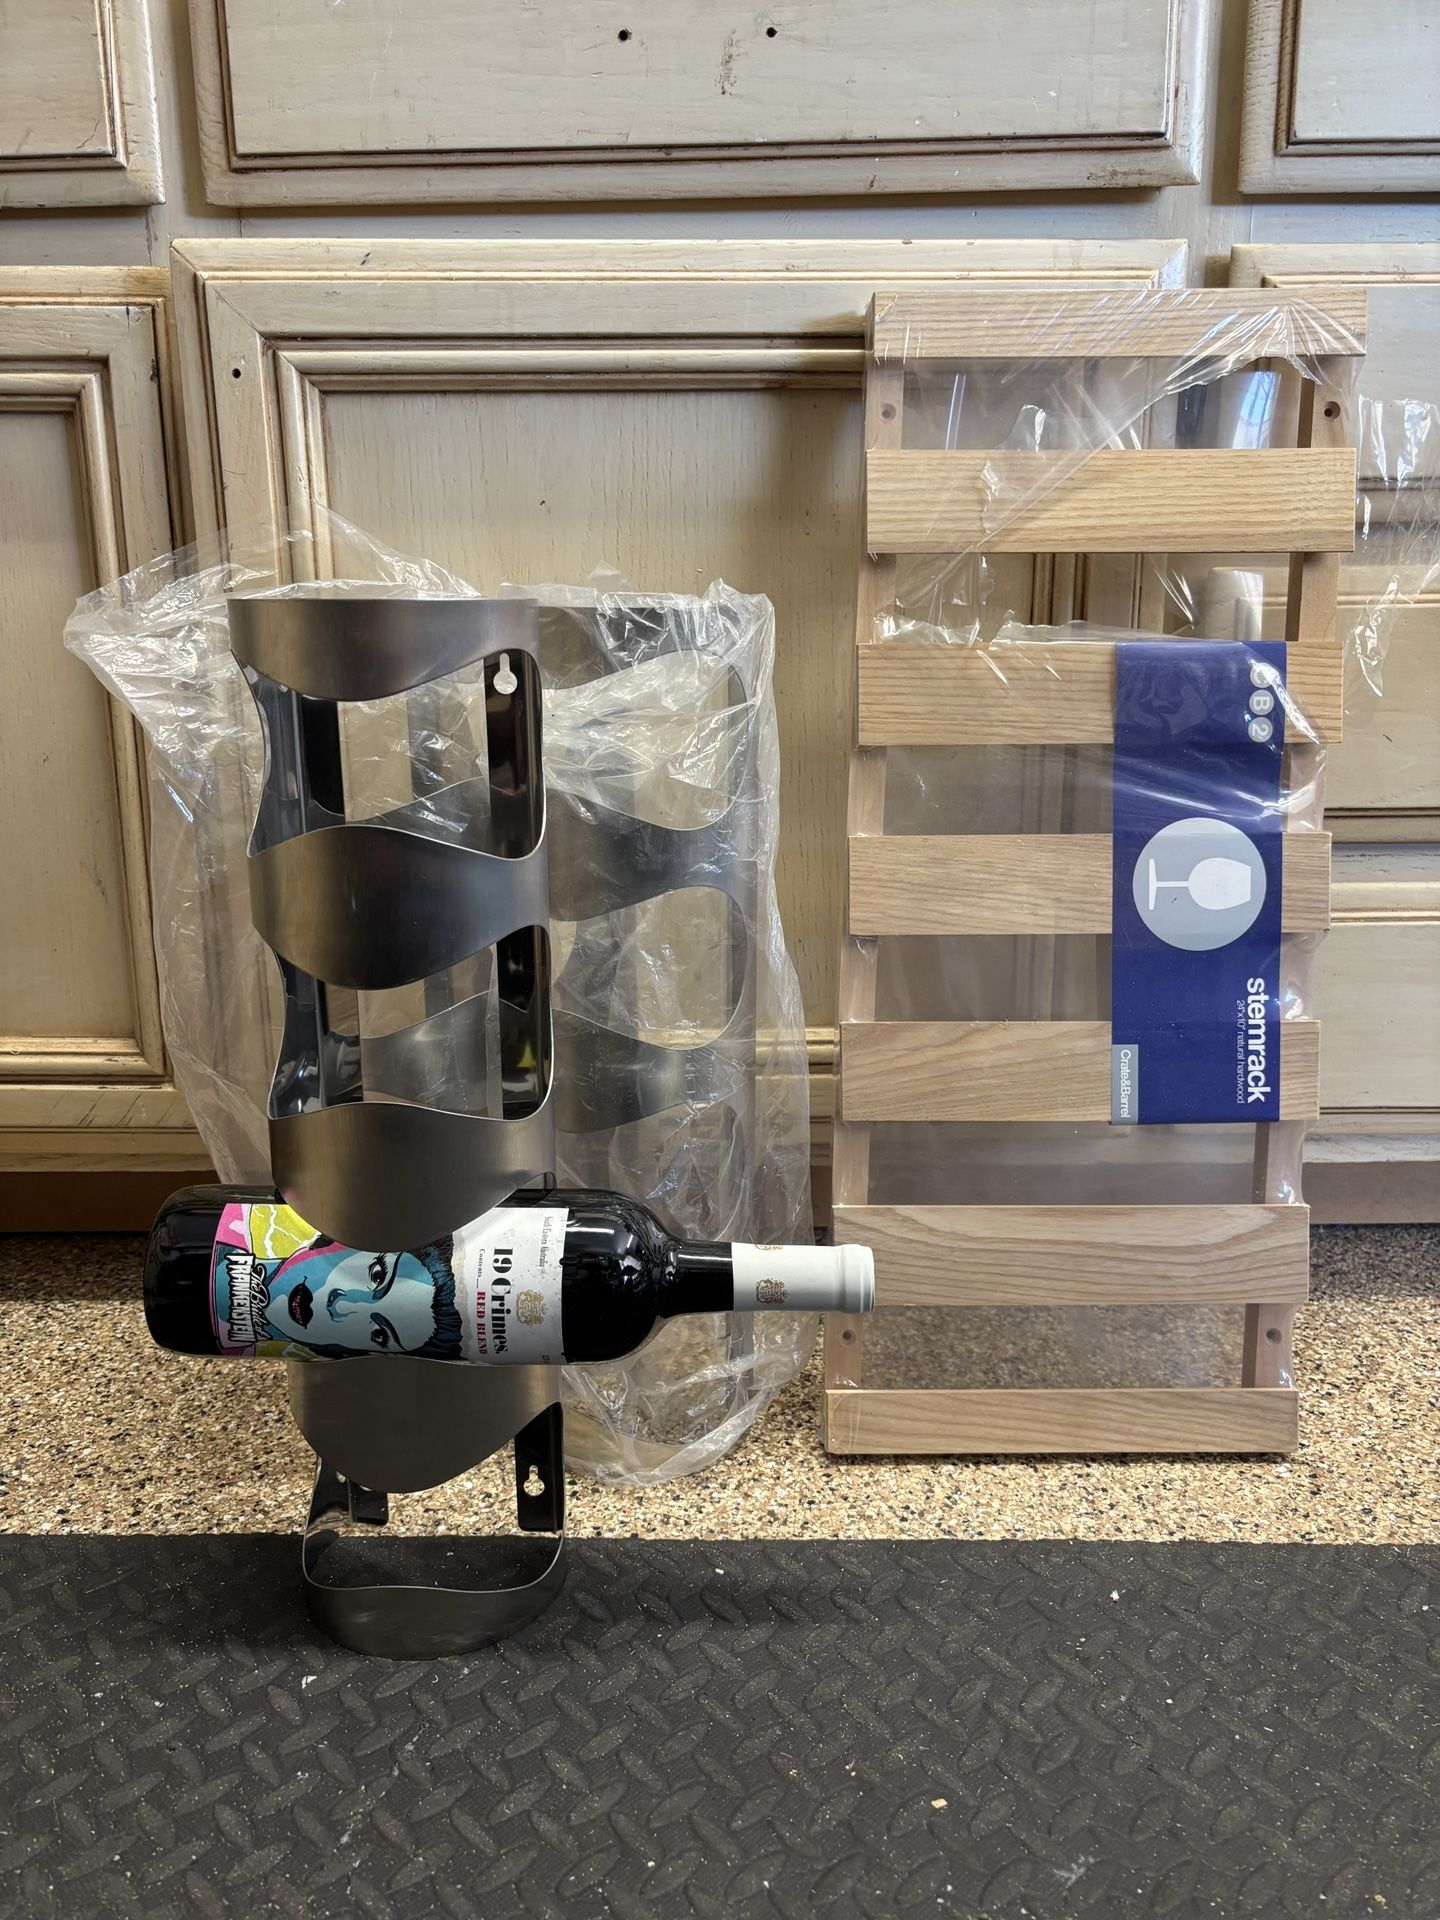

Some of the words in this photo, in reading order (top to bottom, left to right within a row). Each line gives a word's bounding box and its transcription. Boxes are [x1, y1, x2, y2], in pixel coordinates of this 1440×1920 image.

[1236, 1031, 1245, 1060] natural
[1247, 977, 1271, 1104] stemrack
[1120, 1049, 1132, 1118] Crate&Barrel
[1236, 1061, 1246, 1104] hardwood
[541, 1228, 552, 1245] Eastern
[492, 1248, 513, 1274] 19
[539, 1244, 549, 1268] Australia
[250, 1265, 265, 1291] The
[226, 1255, 257, 1341] FRANKENSTEIN
[248, 1286, 269, 1325] Bride
[476, 1291, 486, 1319] RED
[476, 1323, 488, 1355] BLEND
